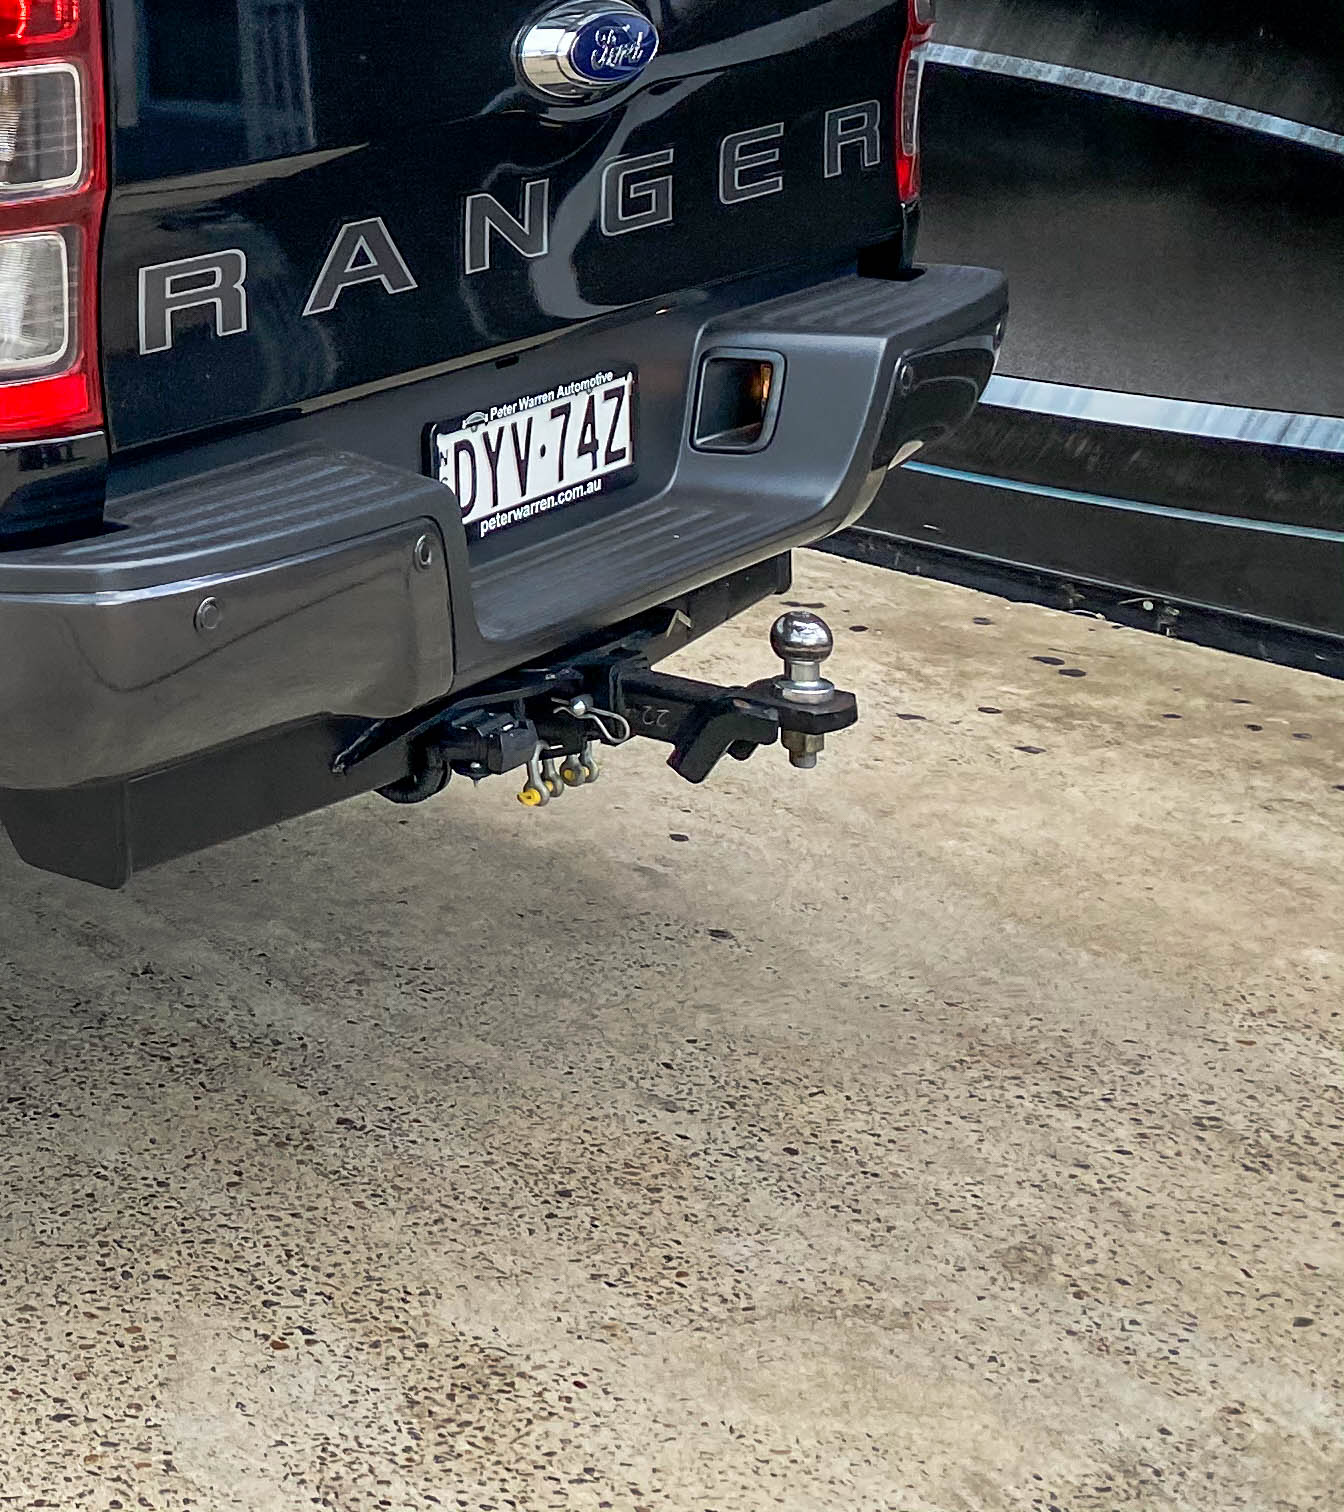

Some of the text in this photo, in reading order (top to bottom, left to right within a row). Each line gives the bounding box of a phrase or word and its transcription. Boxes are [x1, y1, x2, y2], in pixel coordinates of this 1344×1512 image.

[137, 99, 882, 355] RANGER
[489, 369, 614, 421] Peter Warren Automotive
[479, 478, 602, 538] peterwarren.com.au
